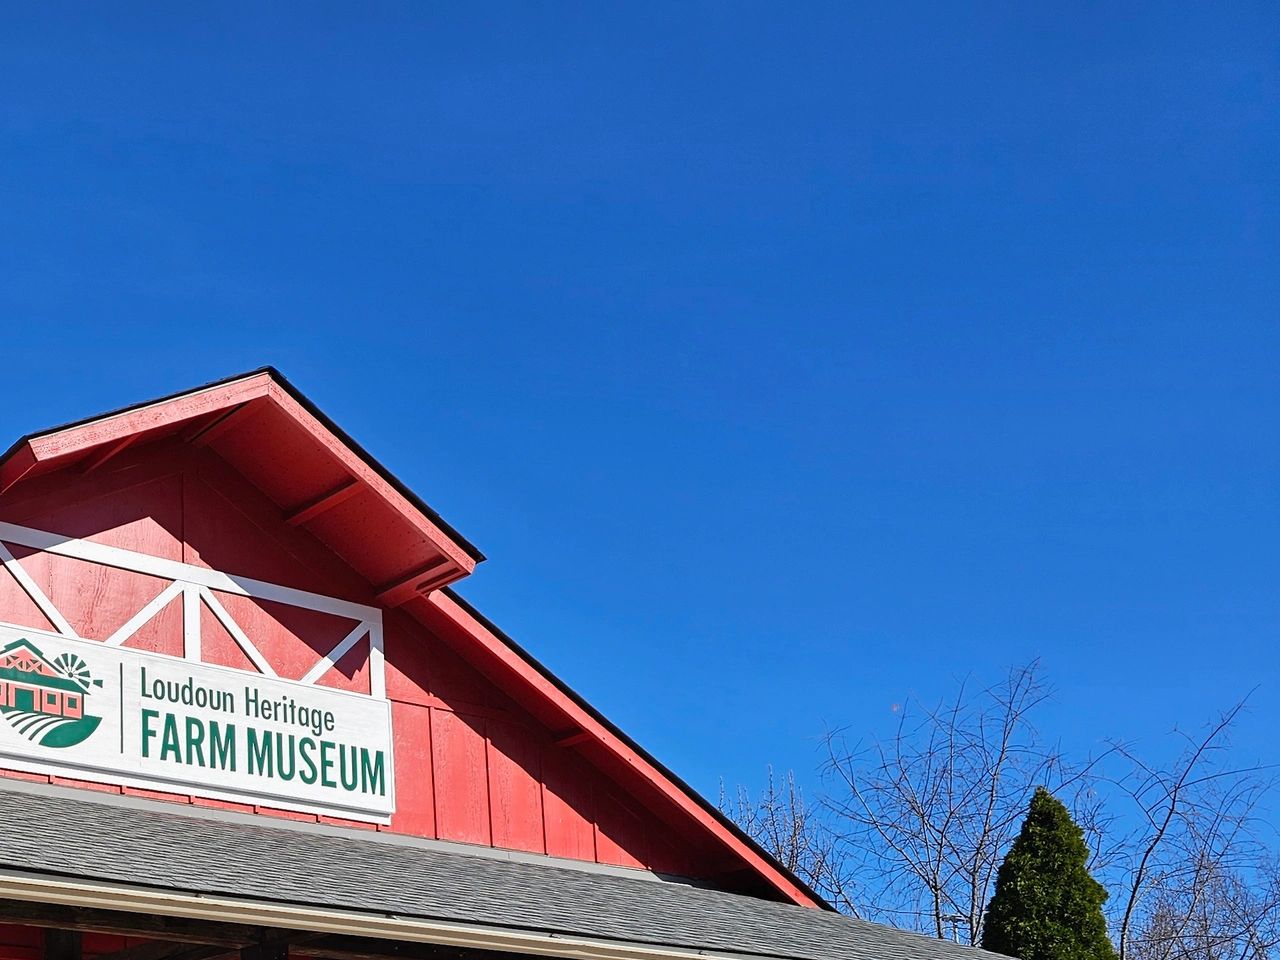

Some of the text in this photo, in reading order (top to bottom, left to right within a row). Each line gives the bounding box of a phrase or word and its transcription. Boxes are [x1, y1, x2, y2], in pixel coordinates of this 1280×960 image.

[140, 666, 335, 737] Loudoun Heritage
[141, 708, 386, 797] FARM MUSEUM
